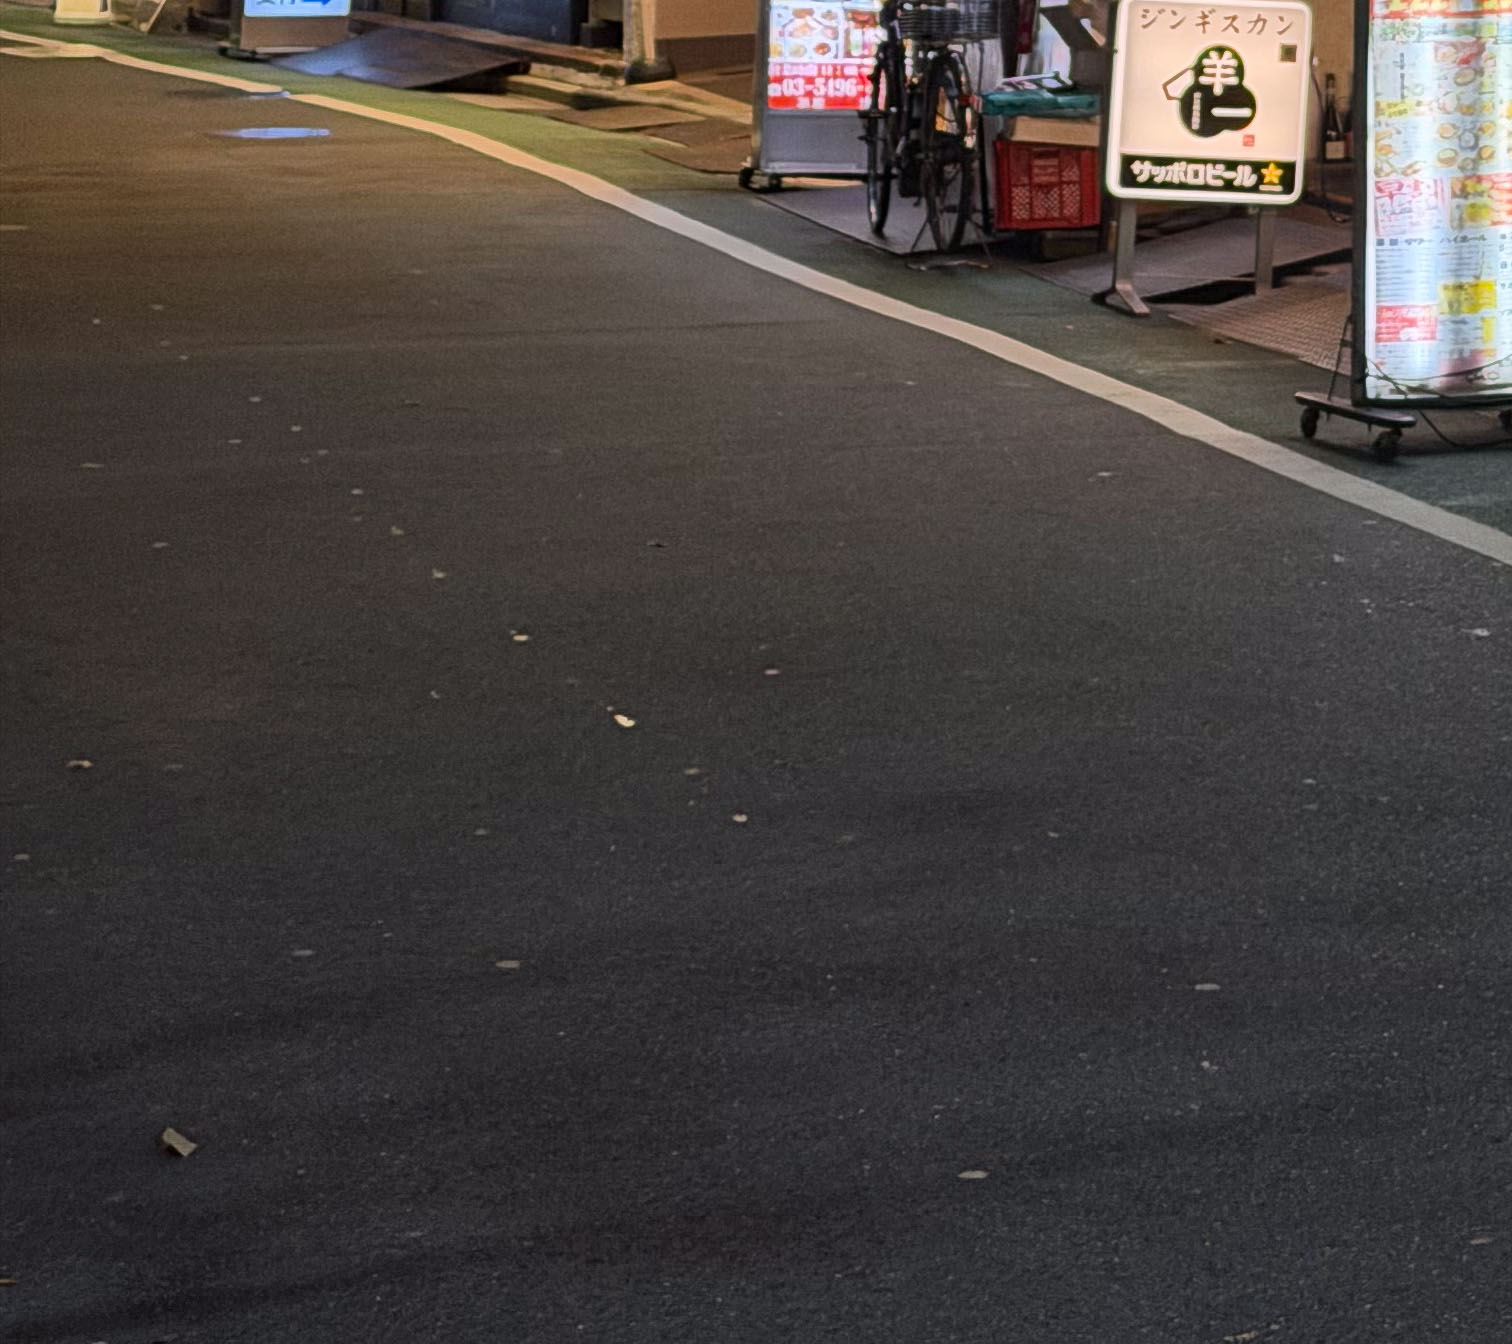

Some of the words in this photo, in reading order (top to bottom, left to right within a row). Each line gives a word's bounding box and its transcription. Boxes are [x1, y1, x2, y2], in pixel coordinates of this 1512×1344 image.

[1141, 8, 1294, 36] ジンギスカン
[1199, 50, 1253, 118] 羊一
[1129, 160, 1257, 188] サッポロビール
